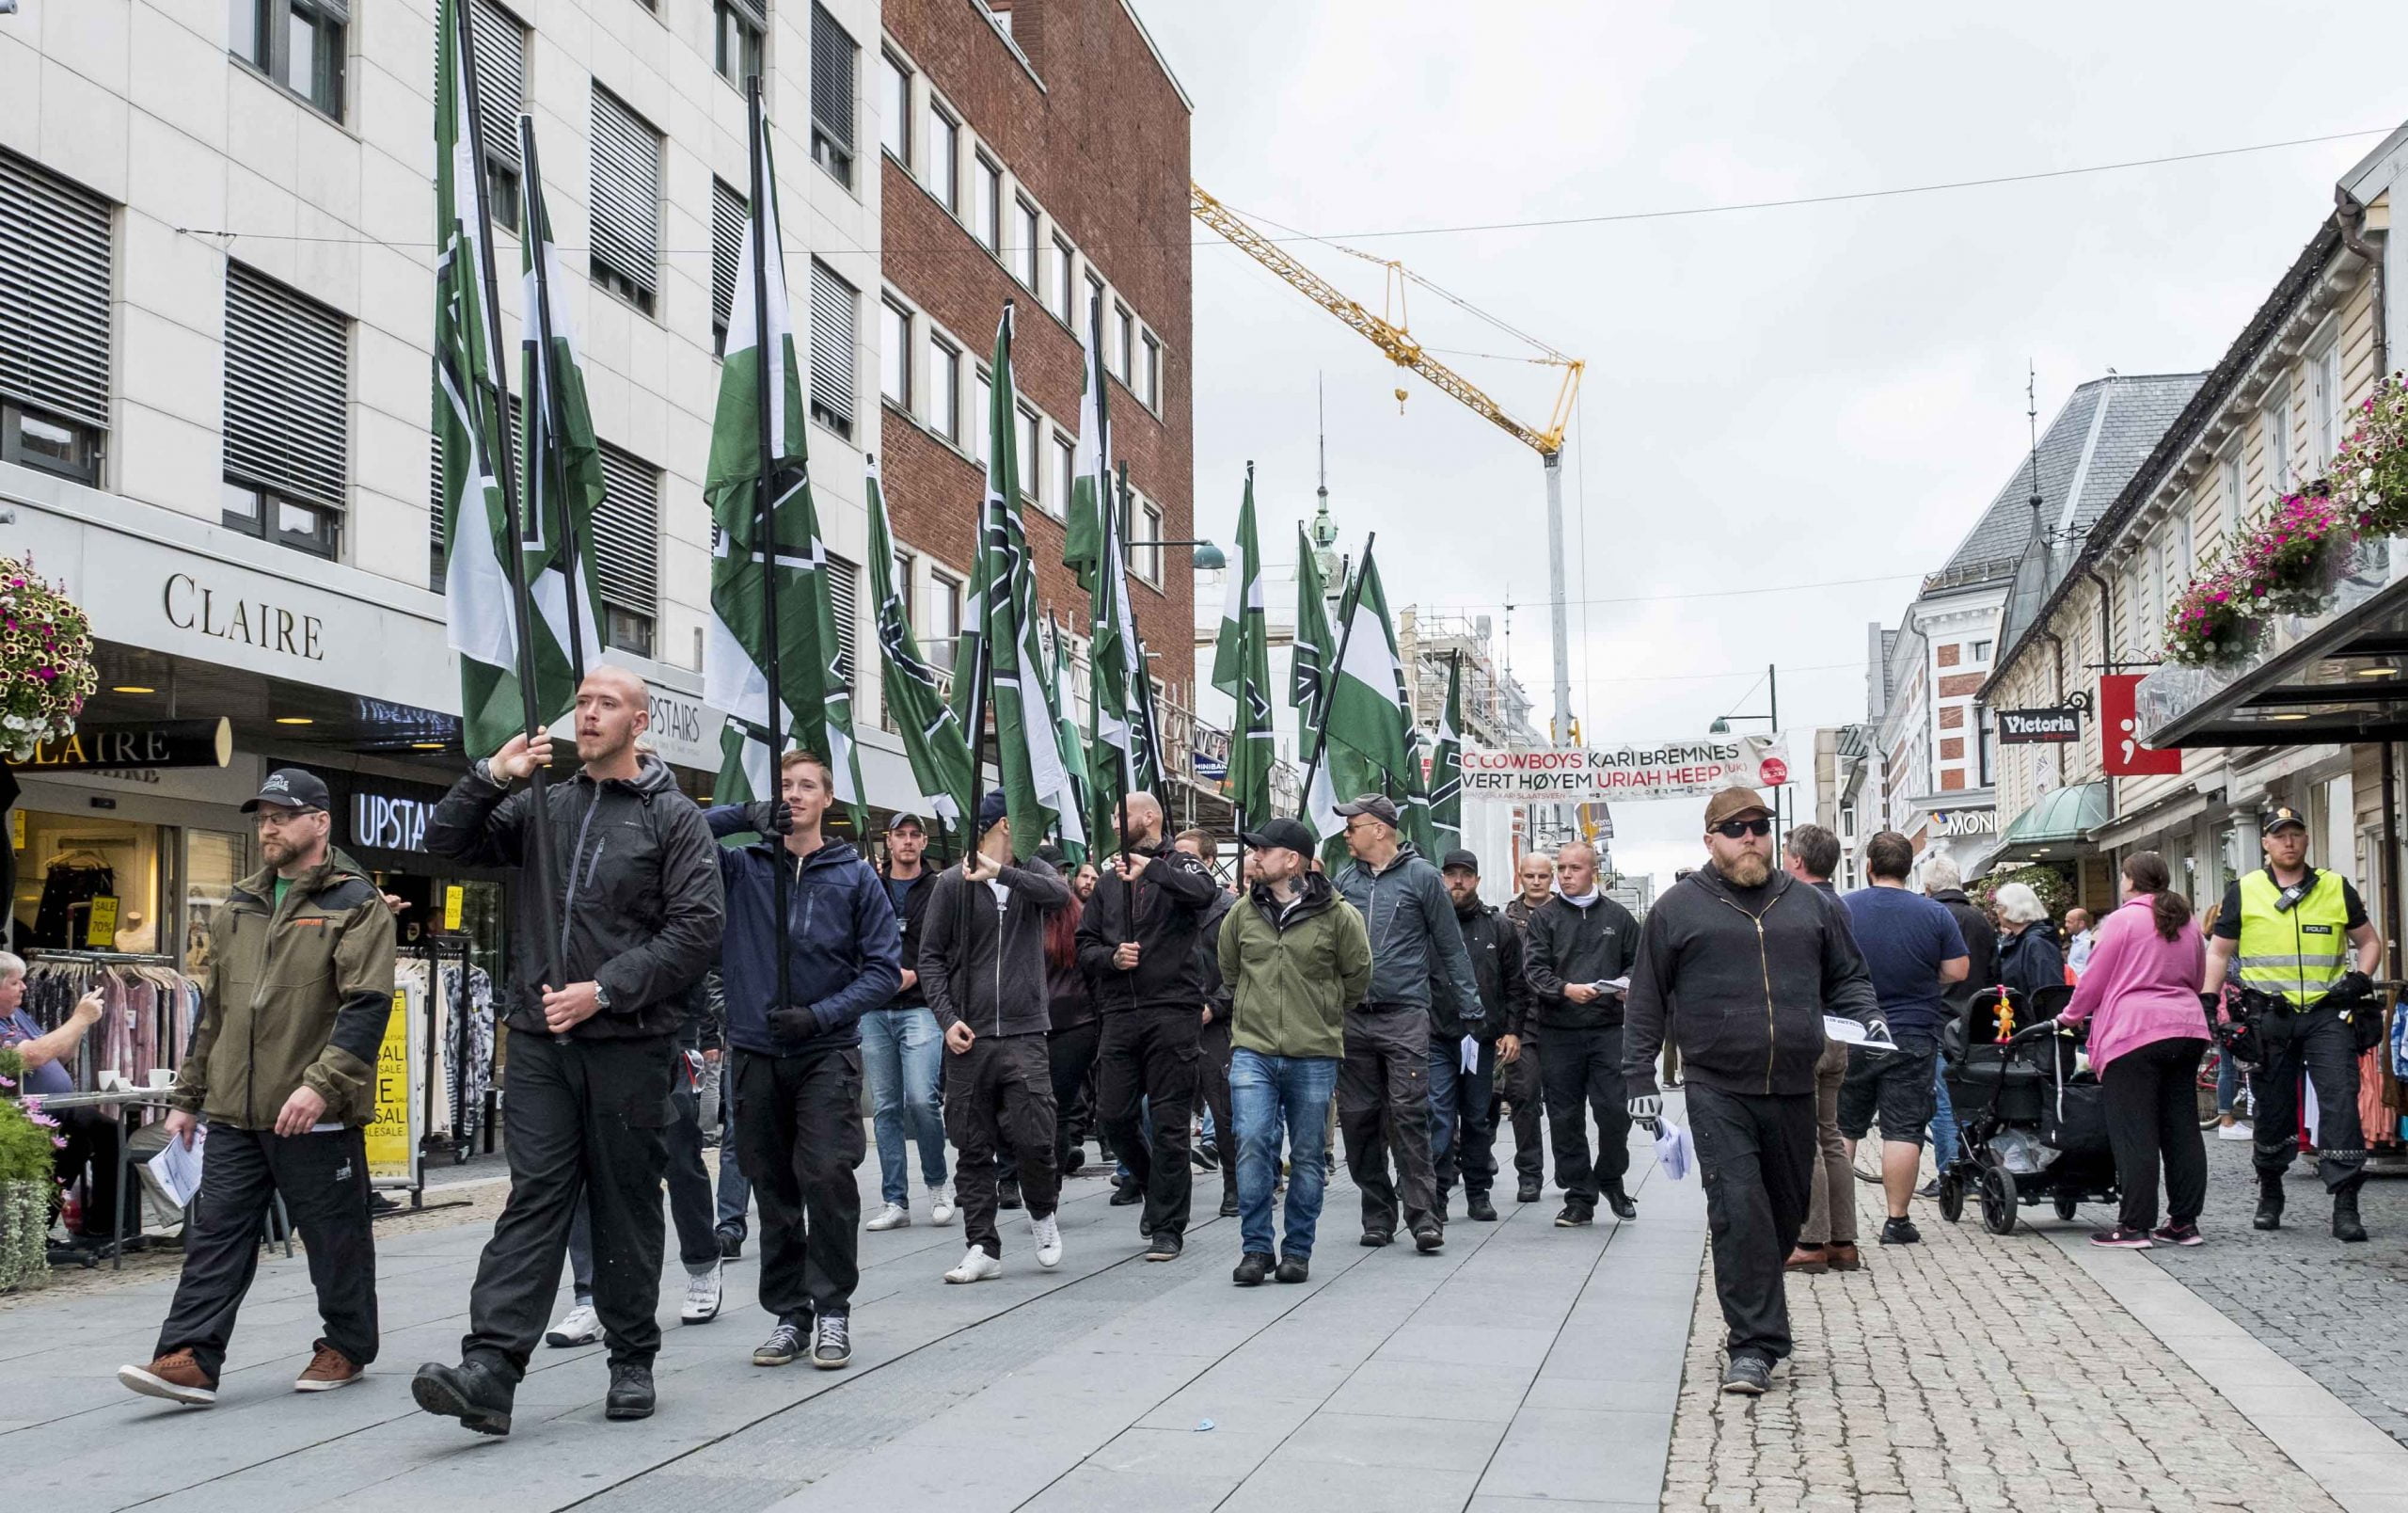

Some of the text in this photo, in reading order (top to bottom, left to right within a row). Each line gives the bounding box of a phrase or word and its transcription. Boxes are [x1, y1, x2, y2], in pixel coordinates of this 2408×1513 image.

[163, 573, 325, 661] CLAIRE
[650, 695, 700, 742] PSTAIRS
[2004, 715, 2076, 733] Victoria
[1461, 743, 1739, 770] C COWBOYS KARI BREMNES
[1462, 772, 1514, 788] VERT
[1519, 772, 1592, 790] HØYEM
[1597, 768, 1662, 788] URIAH
[1667, 765, 1722, 785] HEEP
[1724, 762, 1748, 774] (UK)
[359, 793, 434, 852] UPSTA
[1940, 810, 1998, 836] MON
[95, 900, 116, 912] SALE
[93, 921, 112, 932] 70%
[376, 1107, 409, 1123] SAL
